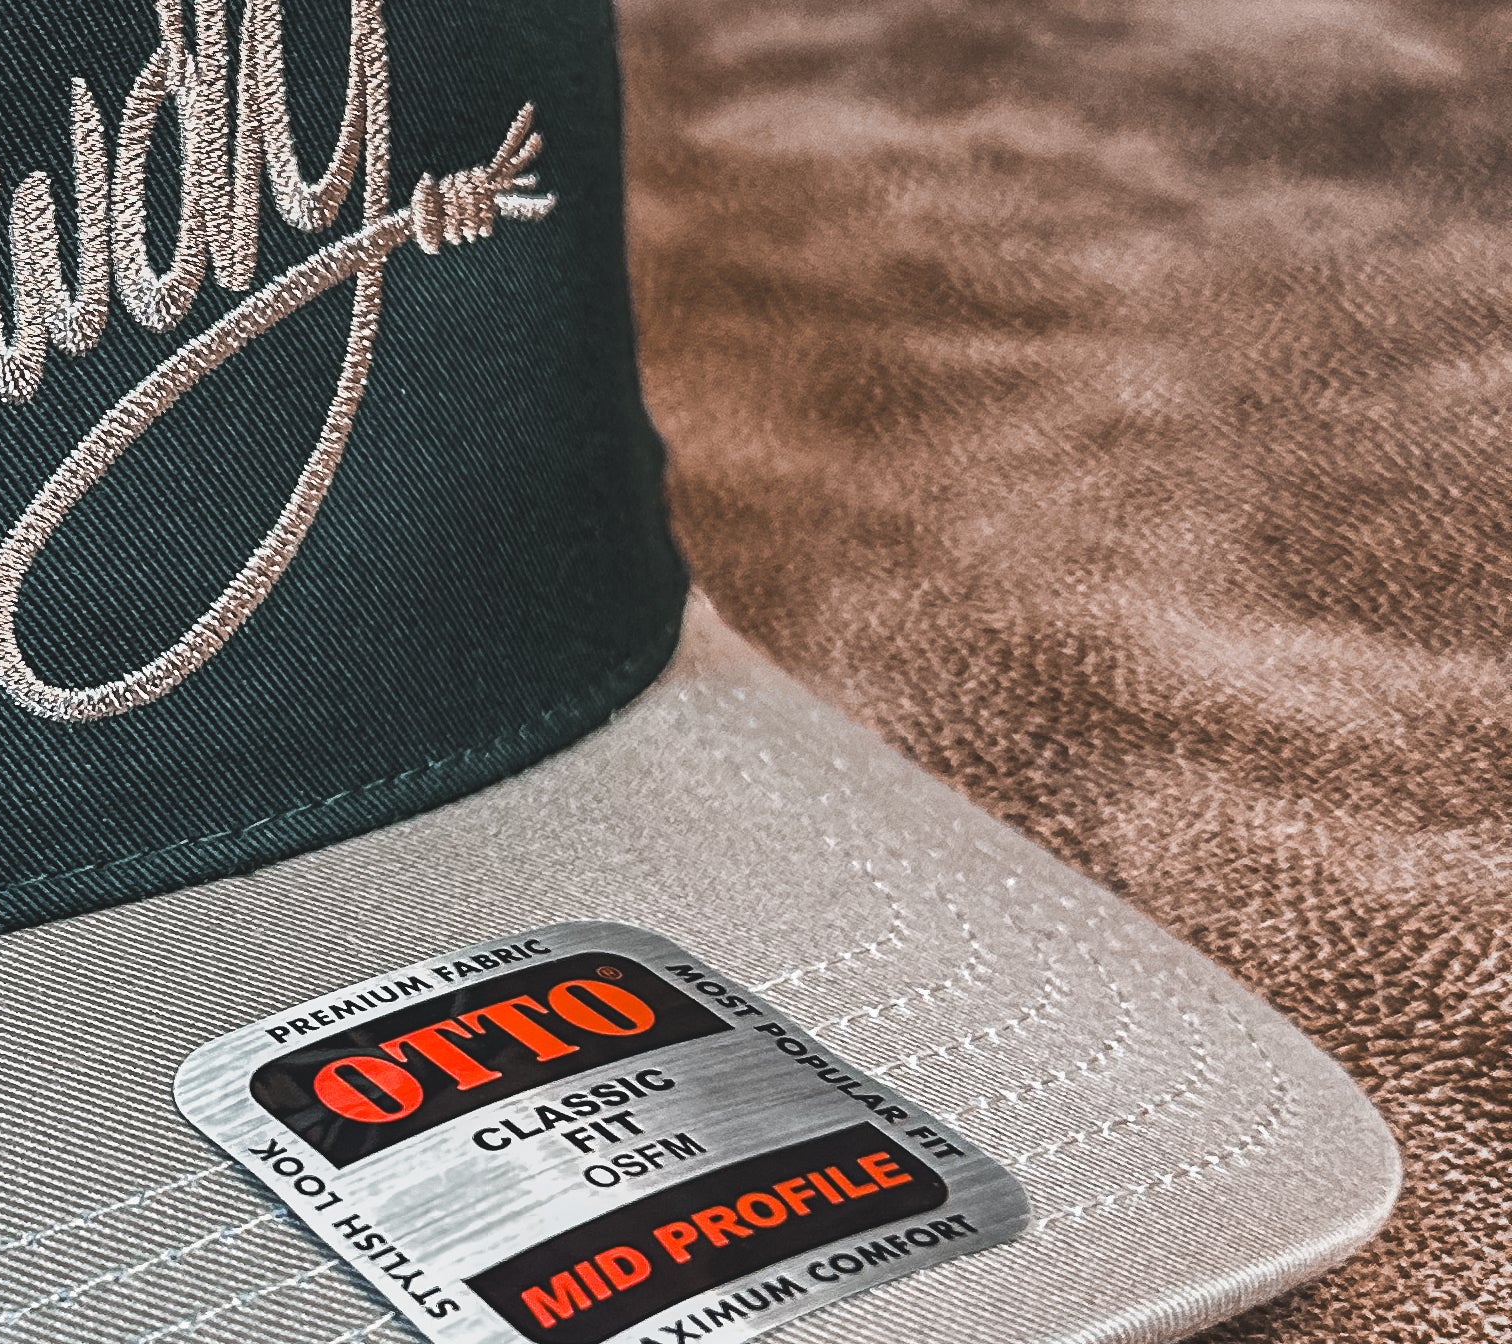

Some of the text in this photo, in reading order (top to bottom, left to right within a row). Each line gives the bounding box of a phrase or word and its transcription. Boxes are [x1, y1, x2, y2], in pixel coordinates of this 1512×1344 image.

[266, 938, 552, 1045] PREMIUM FABRIC
[471, 1068, 676, 1153] CLASSIC
[666, 963, 965, 1162] MOST POPULAR FIT
[561, 1112, 646, 1155] FIT
[583, 1132, 708, 1189] OSFM
[249, 1137, 460, 1320] STYLISH LOOK
[520, 1152, 913, 1330] MID PROFILE
[808, 1214, 979, 1287] COMFORT
